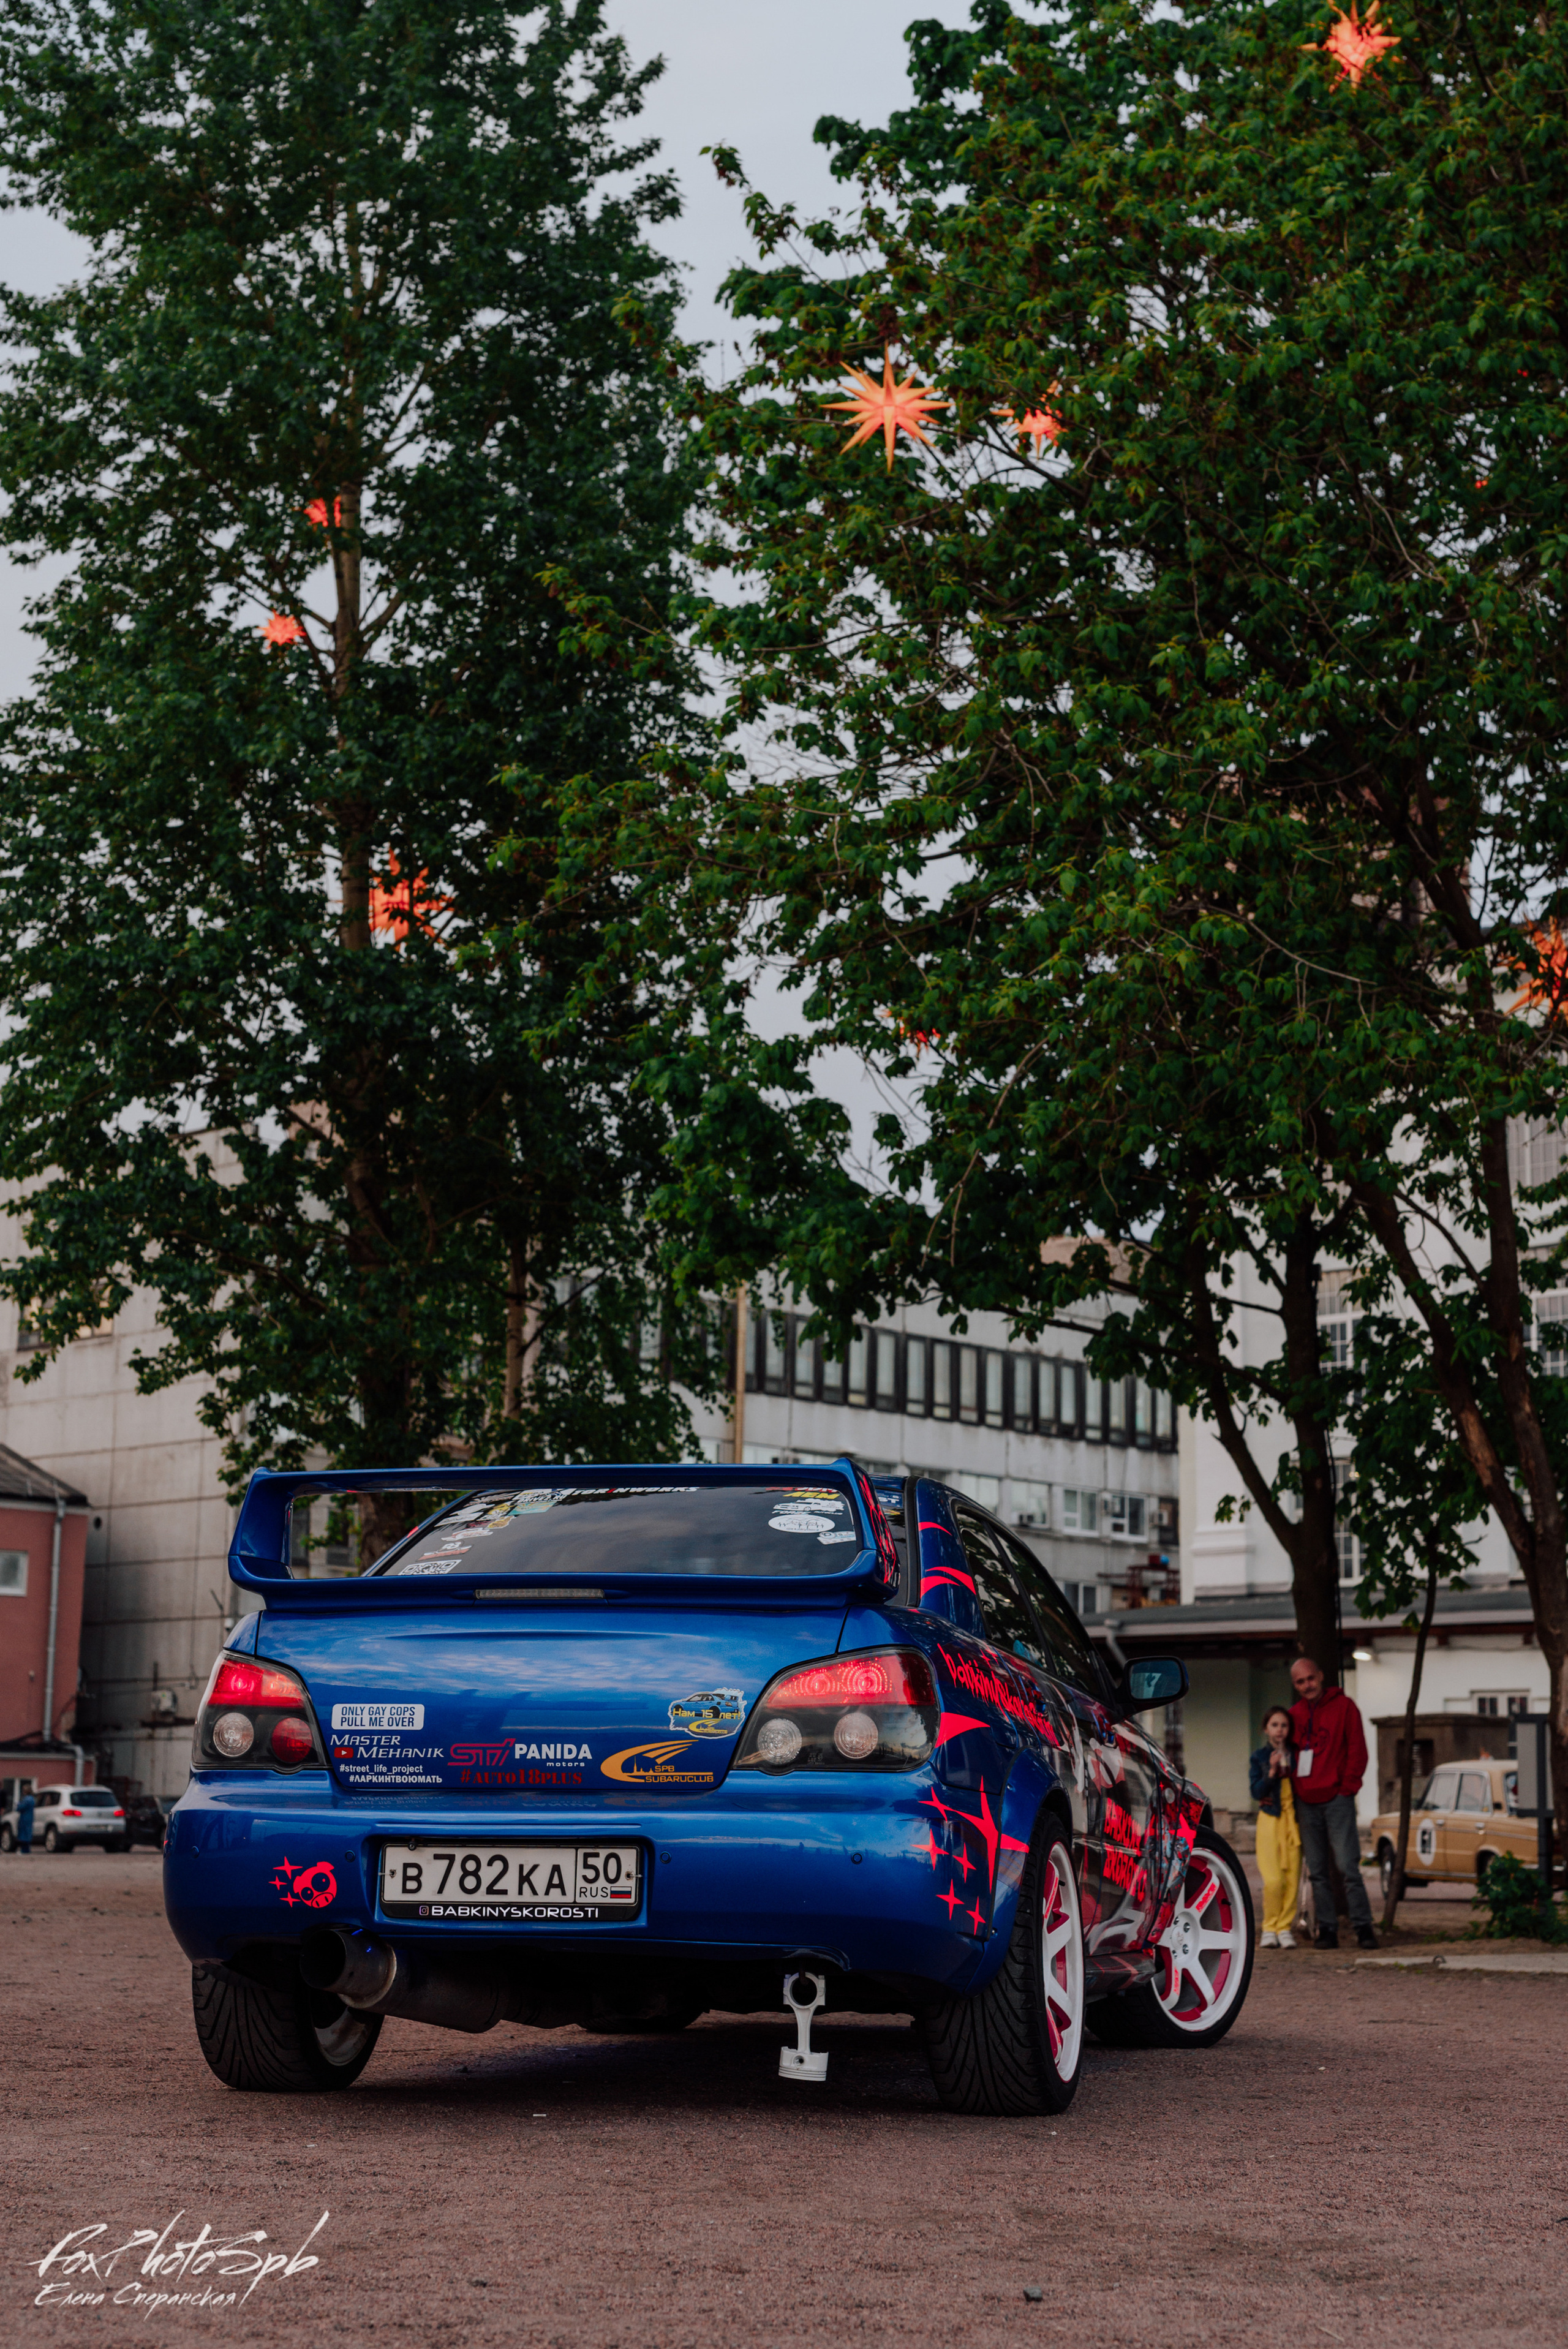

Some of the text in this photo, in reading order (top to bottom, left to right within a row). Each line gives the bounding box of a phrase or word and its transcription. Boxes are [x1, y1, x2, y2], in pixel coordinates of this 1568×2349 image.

[782, 1491, 840, 1499] AEM
[341, 1706, 415, 1716] ONLY GAY COPS
[673, 1708, 695, 1717] Нам
[701, 1710, 713, 1718] 15
[341, 1717, 414, 1727] PULL ME OVER
[330, 1734, 401, 1745] MASTER
[357, 1747, 444, 1758] MEHANIK
[514, 1744, 592, 1759] PANIDA
[340, 1764, 423, 1774] #street_life_project
[460, 1768, 582, 1784] #AUTO18PLUS
[582, 1852, 622, 1884] 50
[579, 1887, 609, 1898] RUS
[431, 1906, 598, 1918] BABKINYSKOROSTI
